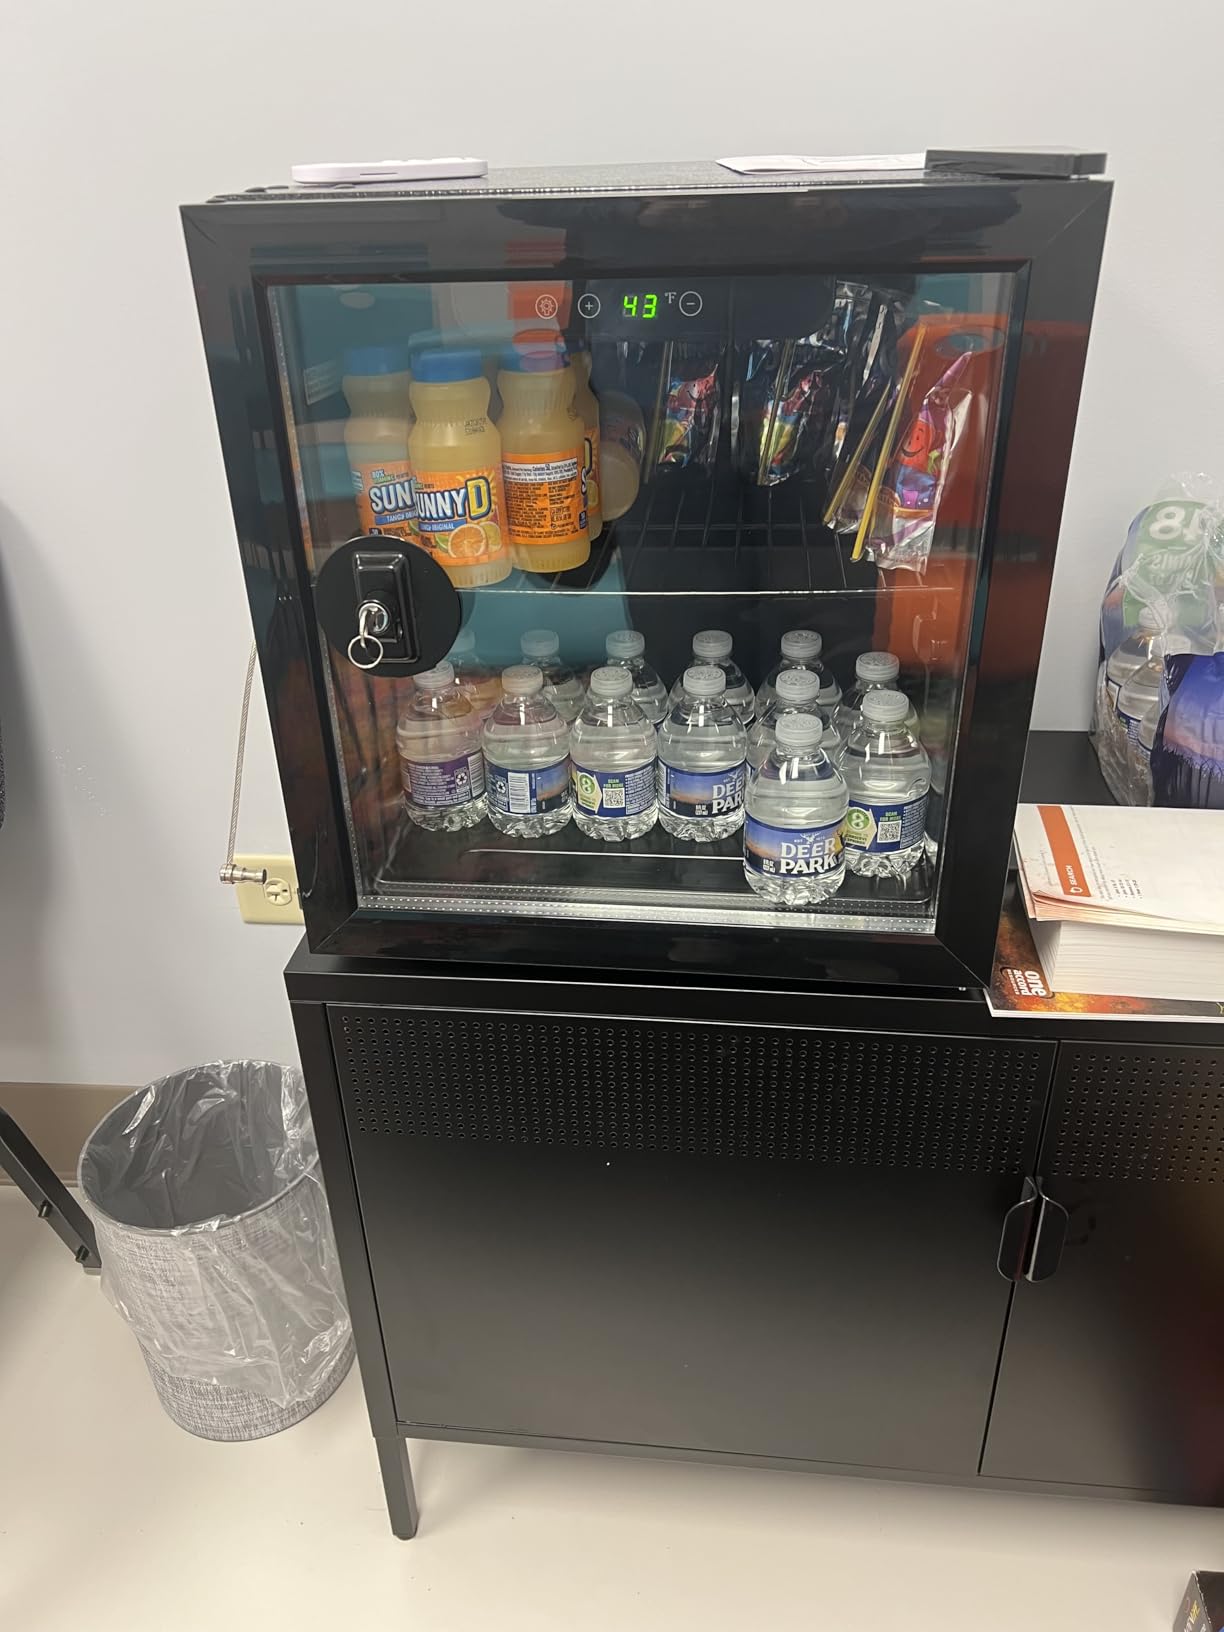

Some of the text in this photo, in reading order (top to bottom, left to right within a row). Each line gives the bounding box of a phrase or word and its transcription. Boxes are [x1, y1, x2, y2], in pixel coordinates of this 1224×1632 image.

[623, 294, 658, 318] 43
[415, 477, 491, 520] UNNYD
[712, 775, 744, 799] DEE
[781, 837, 836, 858] DEER
[779, 853, 837, 874] PARK
[1066, 864, 1078, 886] SEARCH
[1013, 969, 1033, 995] accord
[1024, 971, 1047, 996] one
